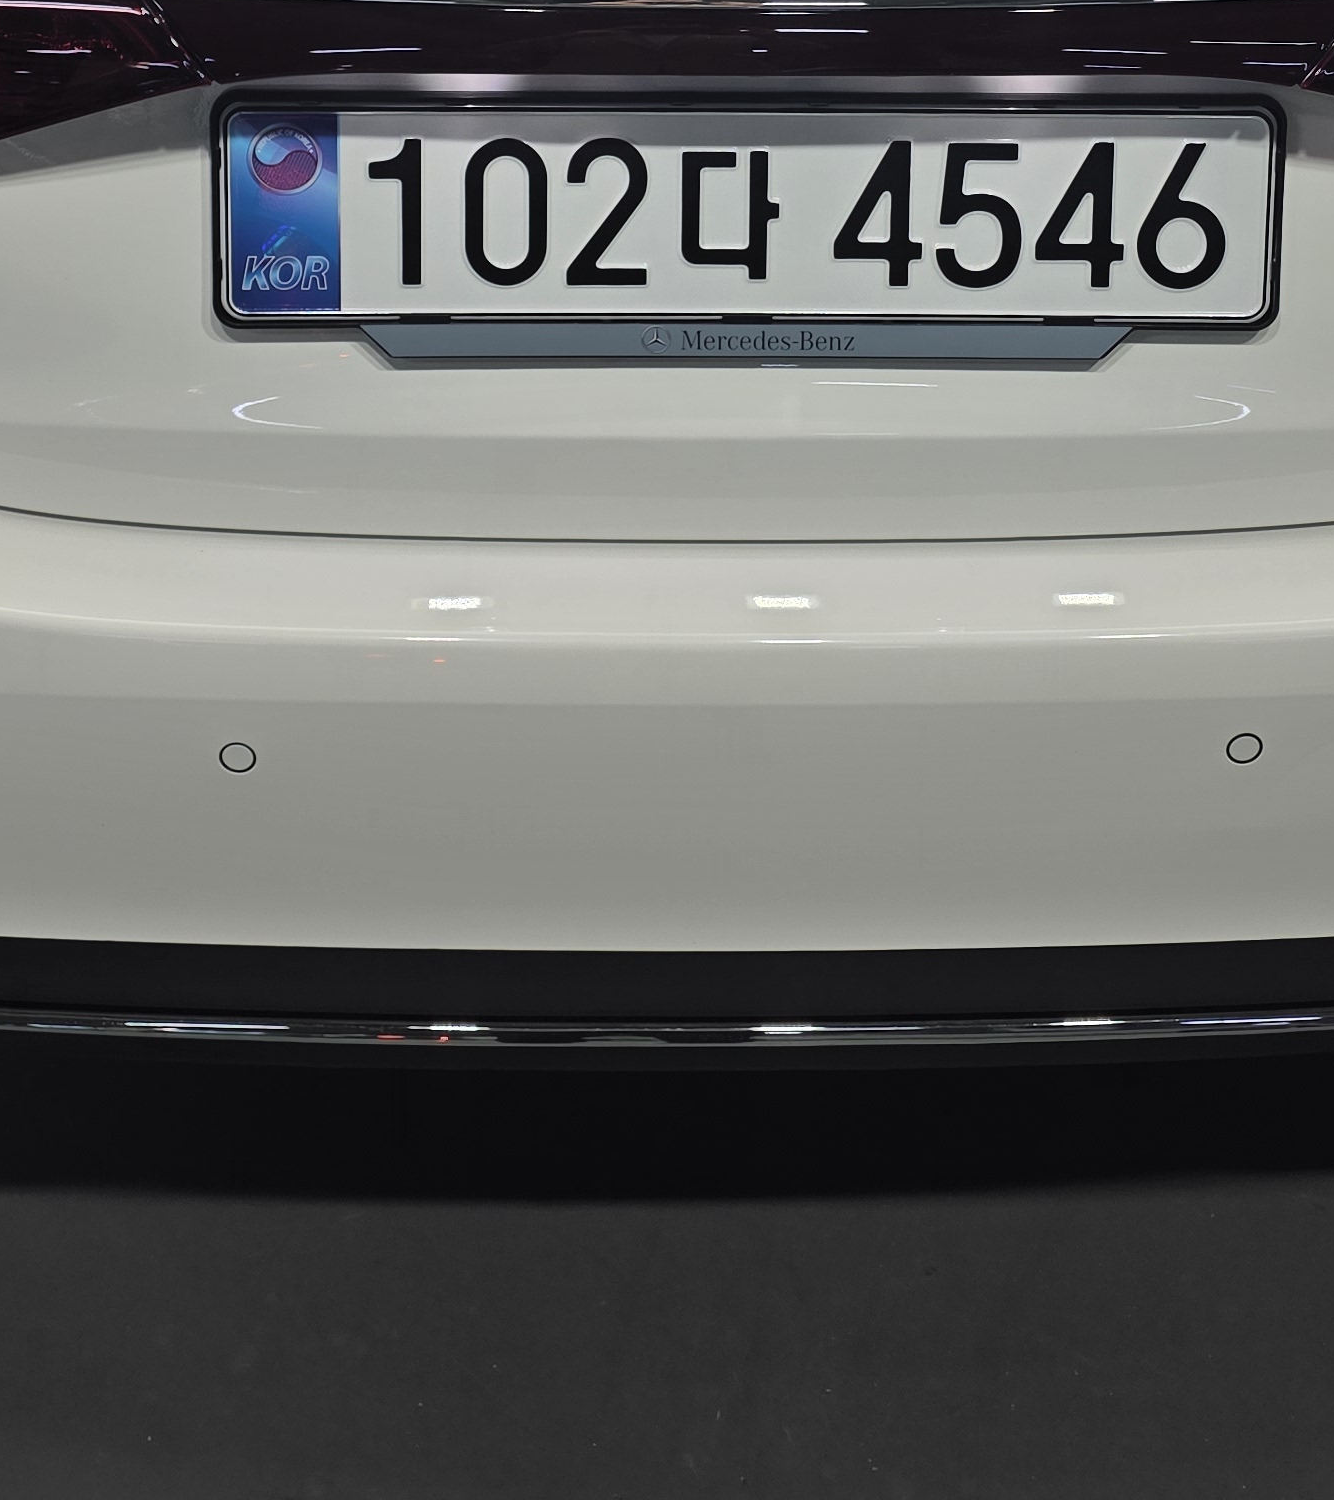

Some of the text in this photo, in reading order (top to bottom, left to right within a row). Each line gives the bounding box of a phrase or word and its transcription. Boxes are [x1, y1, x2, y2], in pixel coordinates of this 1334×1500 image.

[368, 137, 1226, 289] 102다 4546
[242, 256, 329, 290] KOR
[682, 330, 855, 351] Mercedes-Benz
